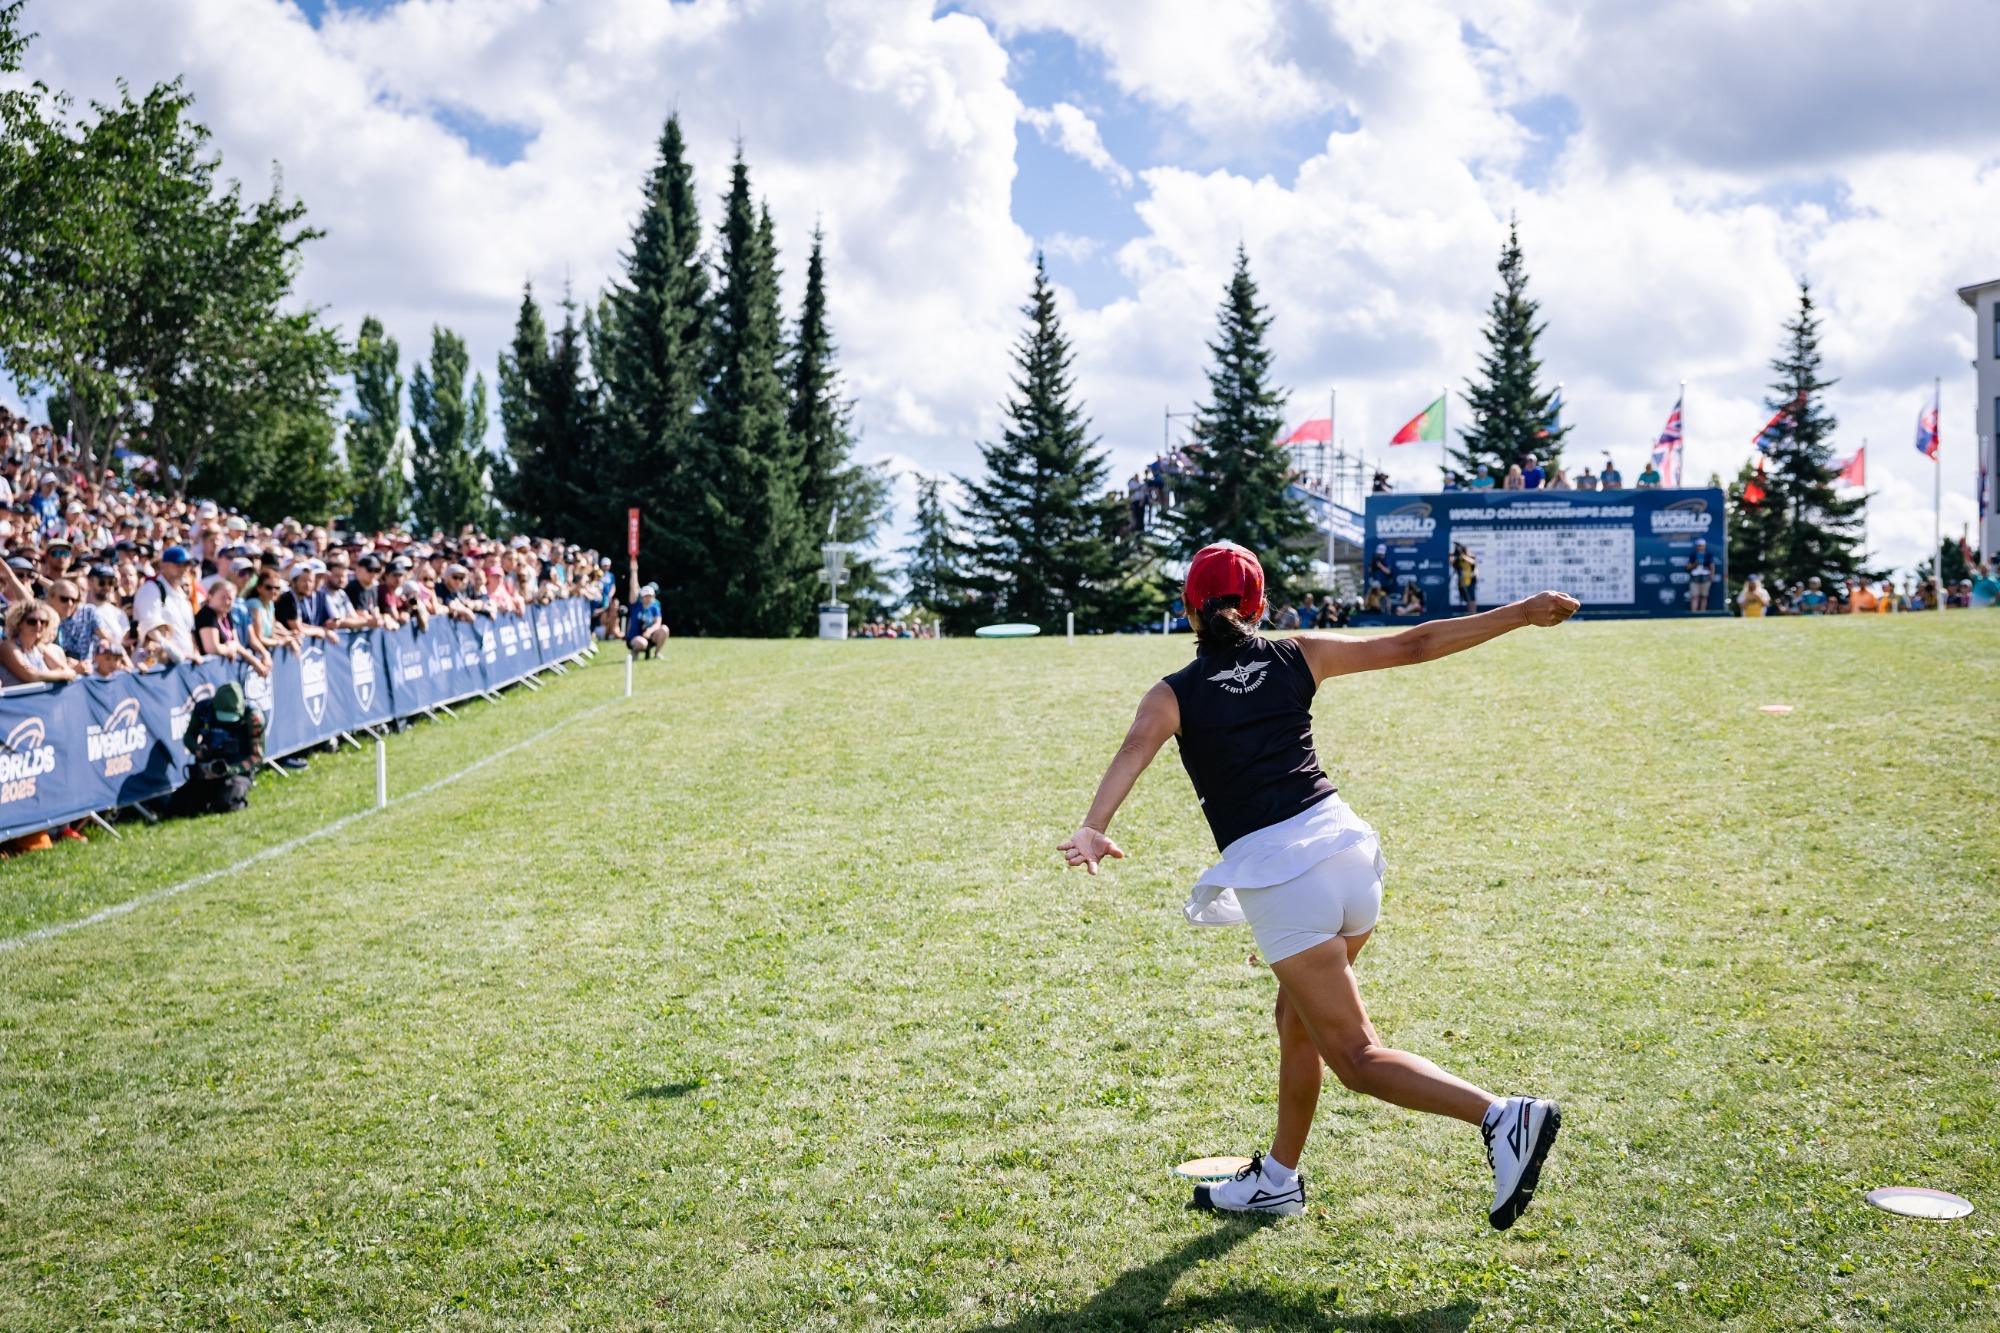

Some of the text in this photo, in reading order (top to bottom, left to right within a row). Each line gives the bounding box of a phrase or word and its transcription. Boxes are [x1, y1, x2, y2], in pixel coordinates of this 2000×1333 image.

[1376, 517, 1437, 532] WORLD
[1449, 508, 1496, 520] WORLD
[1496, 506, 1599, 520] CHAMPIONSHIPS
[1650, 512, 1712, 528] WORLD
[1219, 670, 1268, 694] TEAM INNOVA
[87, 723, 147, 762] WORLDS
[0, 745, 55, 783] ORLDS
[1, 777, 36, 804] 2025
